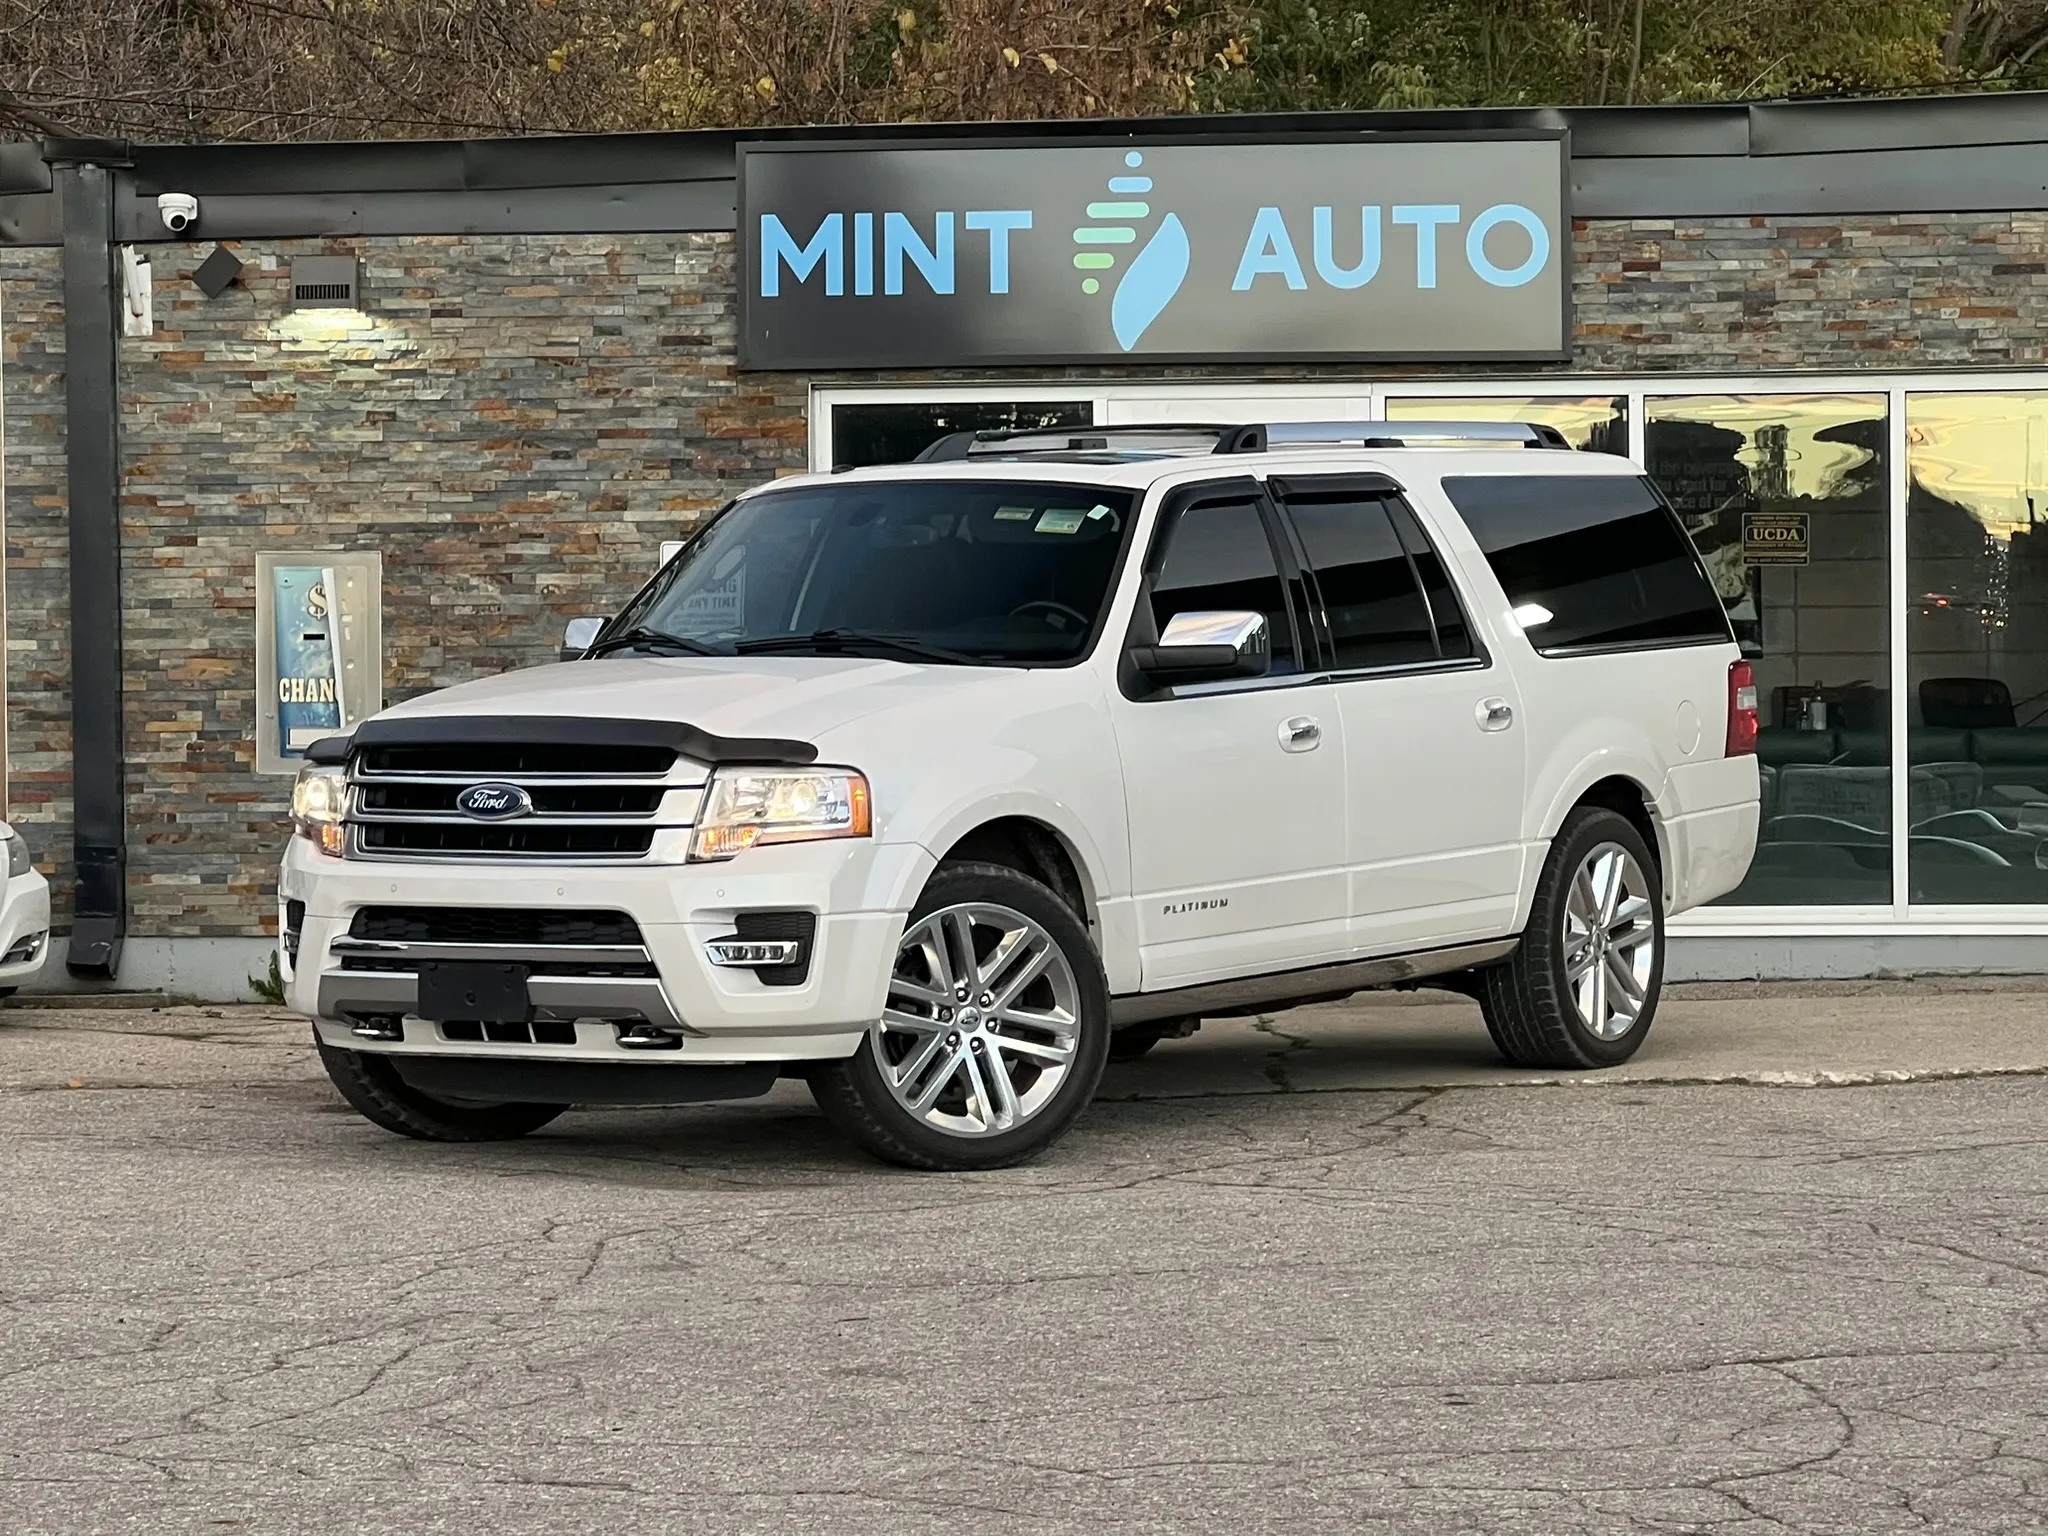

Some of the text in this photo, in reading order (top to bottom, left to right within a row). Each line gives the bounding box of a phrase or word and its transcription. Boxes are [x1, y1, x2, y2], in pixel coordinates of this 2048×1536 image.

[760, 203, 1550, 297] MINT AUTO
[1753, 528, 1799, 541] UCDA
[307, 582, 329, 621] $
[468, 789, 509, 809] Ford
[1163, 898, 1229, 915] PLATINUM
